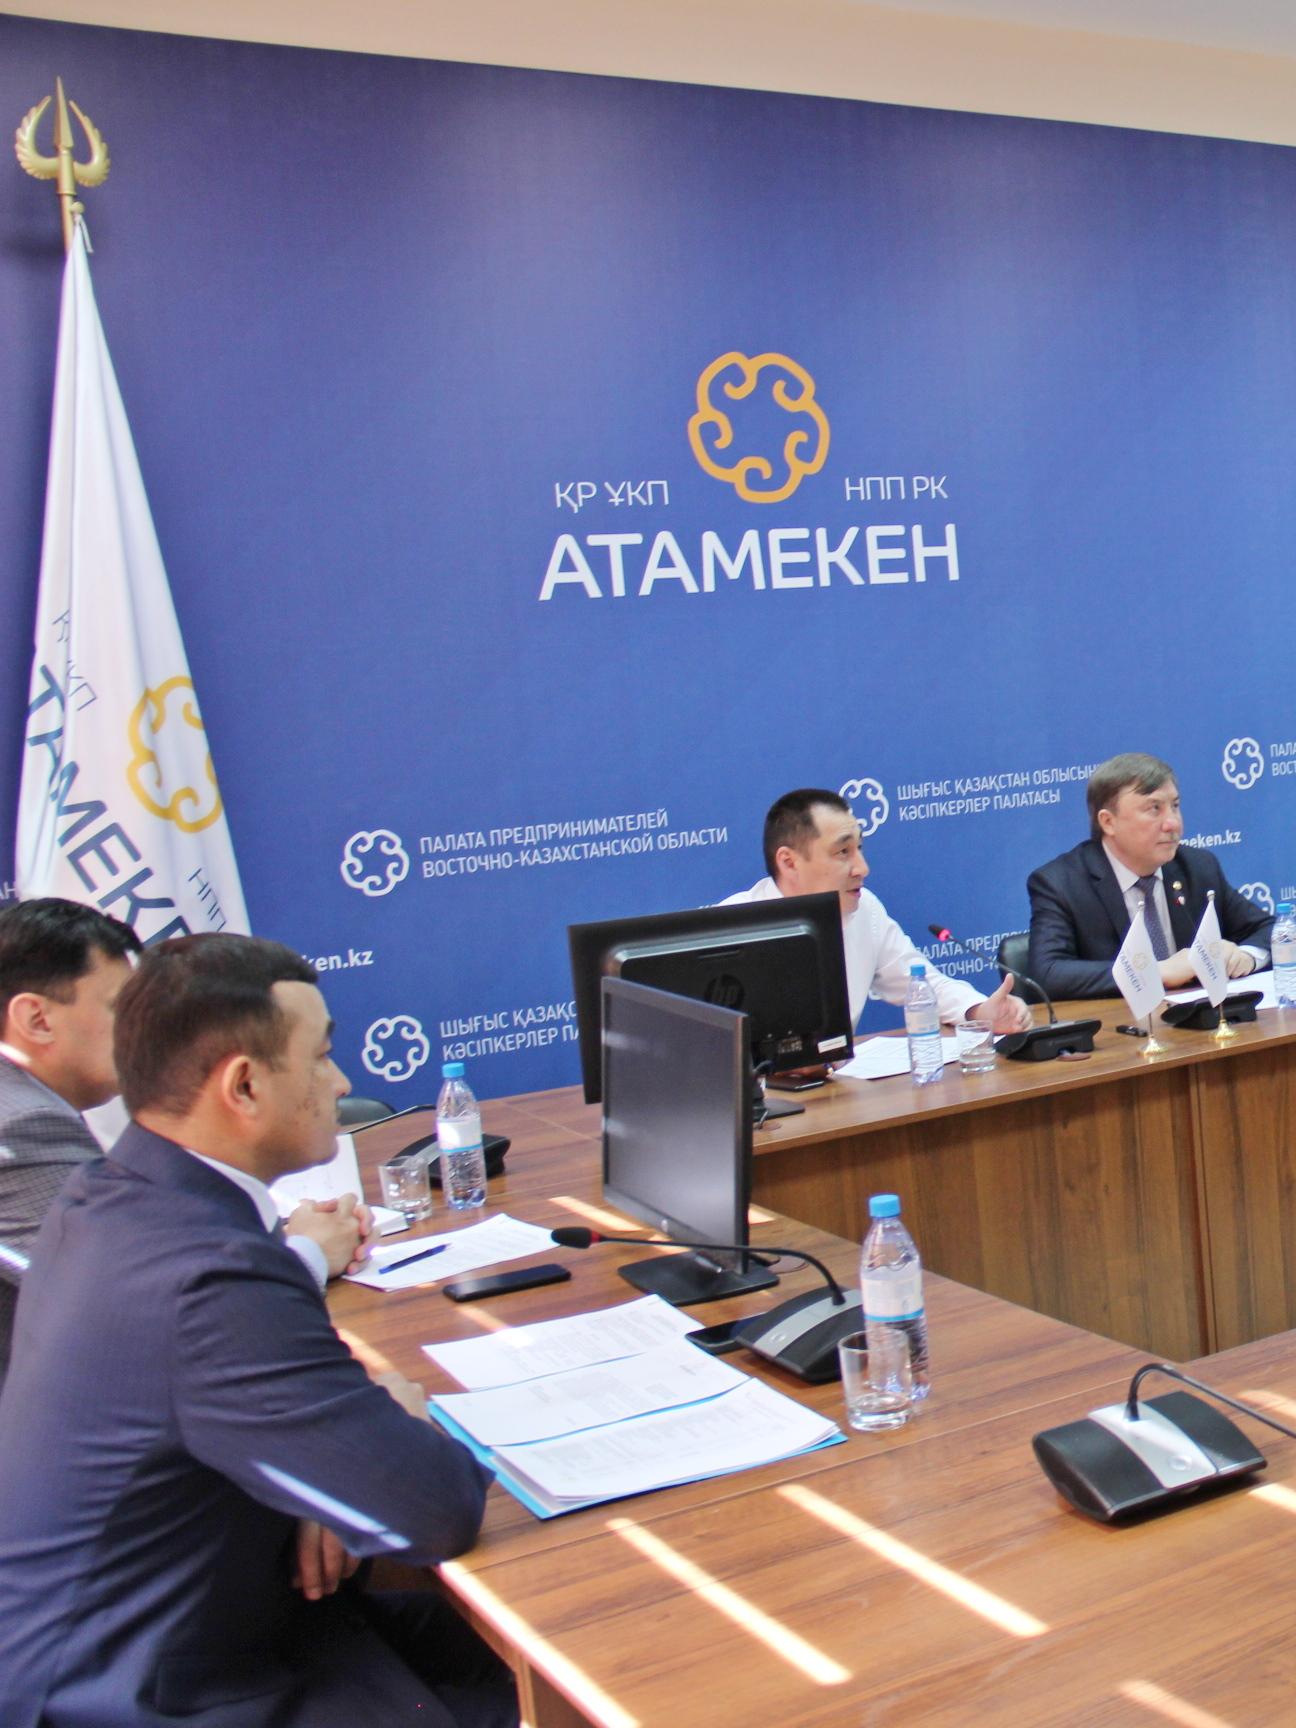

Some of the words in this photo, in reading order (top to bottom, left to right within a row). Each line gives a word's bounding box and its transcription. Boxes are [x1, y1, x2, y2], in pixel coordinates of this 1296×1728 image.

[554, 482, 597, 514] ҚР
[844, 477, 905, 501] НПП
[912, 475, 948, 500] РК
[538, 523, 960, 601] АТАМЕКЕН
[897, 780, 952, 801] ШЫҒЫС
[954, 771, 1030, 796] ҚАЗАҚСТАН
[1032, 763, 1104, 785] ОБЛЫСЫН
[993, 788, 1061, 810] ПАЛАТАСЫ
[419, 832, 486, 855] ПАЛАТА
[489, 807, 669, 847] ПРЕДПРИНИМАТЕЛЕЙ
[422, 838, 654, 878] ВОСТОЧНО-КАЗАХСТАНСКОЙ
[657, 826, 729, 850] ОБЛАСТИ
[916, 940, 964, 960] АЛАТА
[440, 1012, 509, 1038] ШЫҒЫС
[512, 1000, 577, 1029] ҚАЗАҚС
